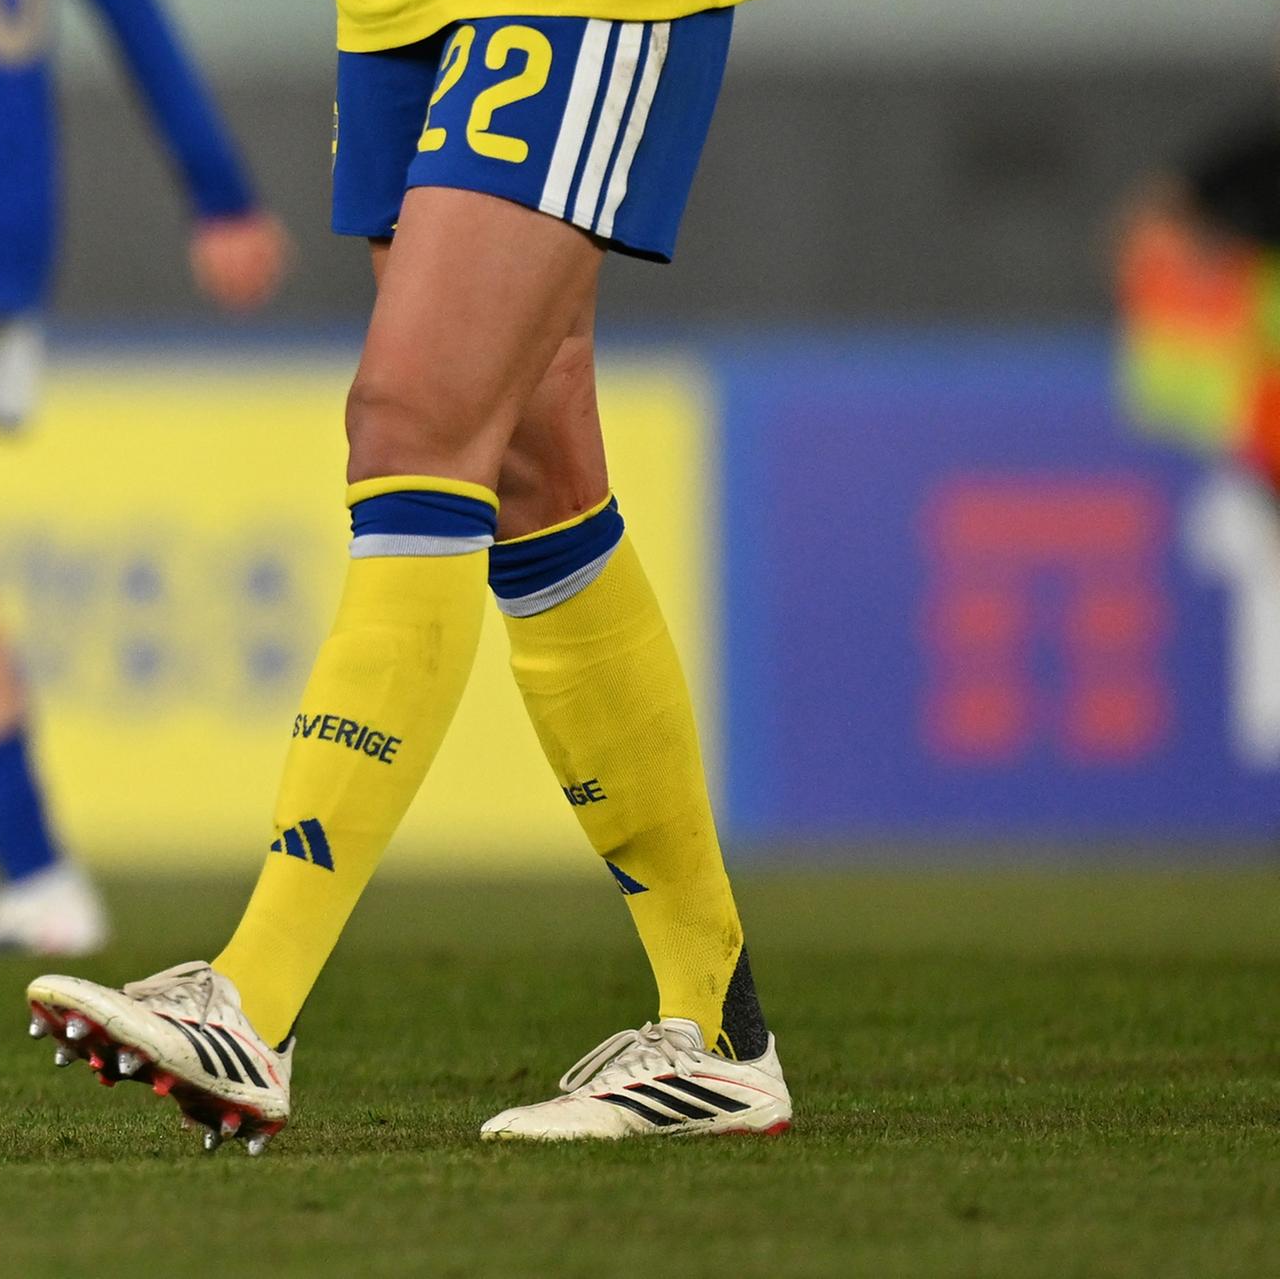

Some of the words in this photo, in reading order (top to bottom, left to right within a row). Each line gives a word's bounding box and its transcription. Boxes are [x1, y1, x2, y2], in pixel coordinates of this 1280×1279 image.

[417, 24, 553, 164] 22
[292, 712, 403, 765] SVERIGE
[562, 778, 608, 807] IGE
